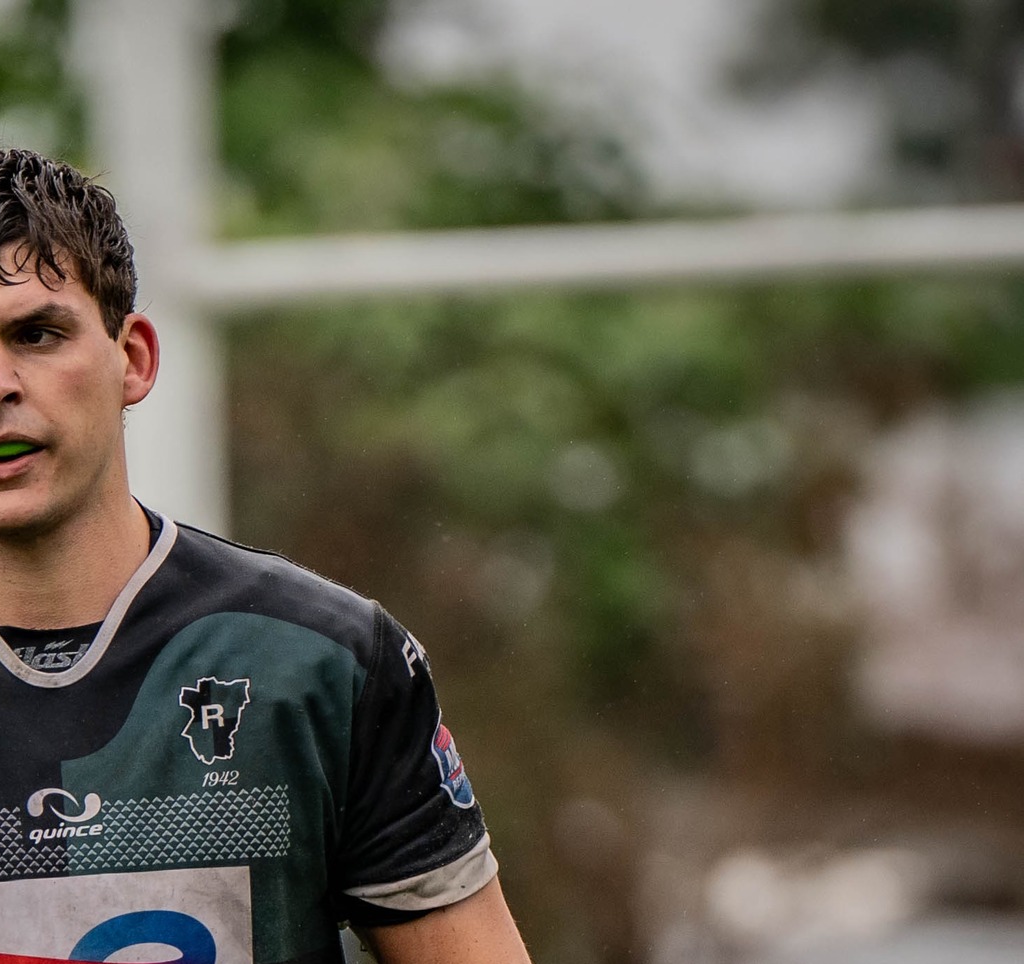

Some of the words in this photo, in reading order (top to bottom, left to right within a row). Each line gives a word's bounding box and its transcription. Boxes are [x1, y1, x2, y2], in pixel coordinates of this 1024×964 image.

[201, 704, 224, 730] R
[202, 769, 239, 787] 1942
[29, 822, 104, 844] quince
